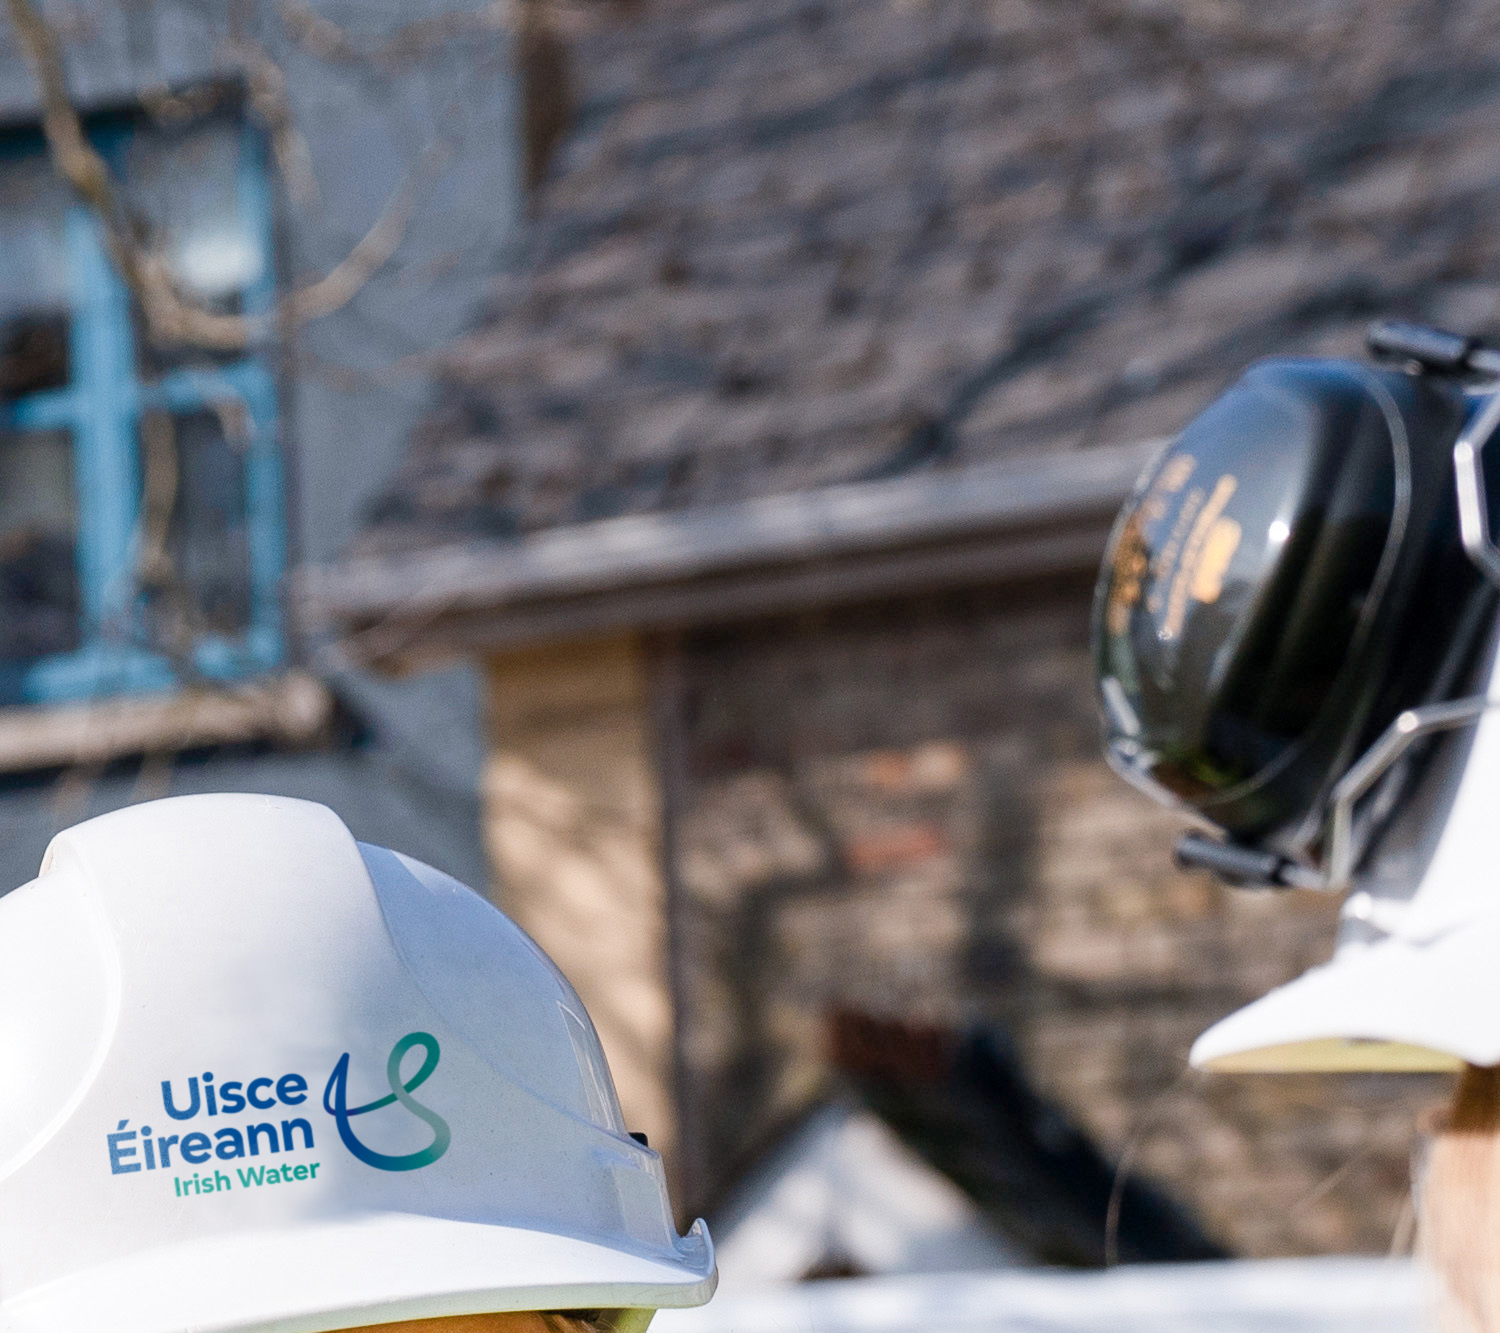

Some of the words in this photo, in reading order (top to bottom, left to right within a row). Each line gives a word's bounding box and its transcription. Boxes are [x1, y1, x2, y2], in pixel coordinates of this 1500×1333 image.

[160, 1071, 309, 1121] Uisce
[106, 1117, 315, 1175] Éireann
[173, 1169, 232, 1197] Irish
[236, 1161, 321, 1188] Water
